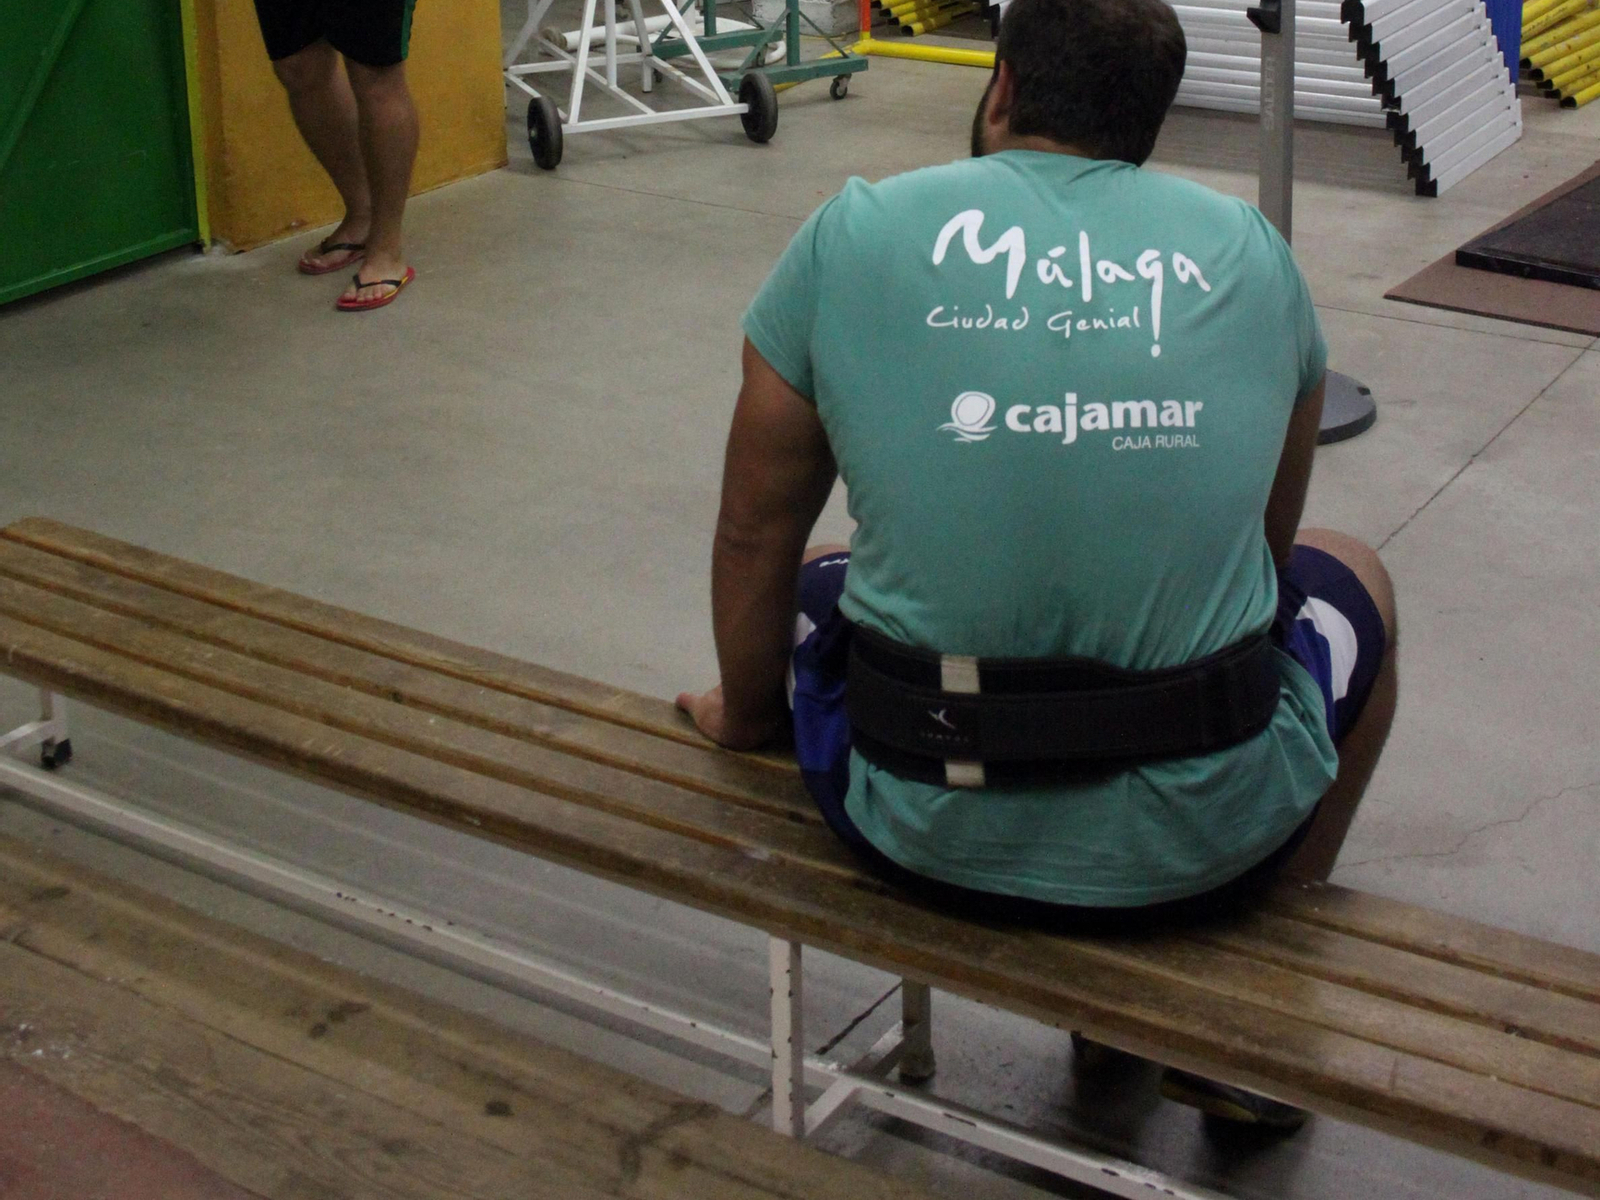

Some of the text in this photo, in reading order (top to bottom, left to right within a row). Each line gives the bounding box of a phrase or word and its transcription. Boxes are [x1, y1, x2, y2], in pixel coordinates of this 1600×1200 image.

[932, 208, 1212, 357] Málaga
[926, 303, 1141, 339] Ciudad Genial
[1005, 392, 1204, 445] cajamar
[1112, 434, 1200, 451] CAJA RURAL
